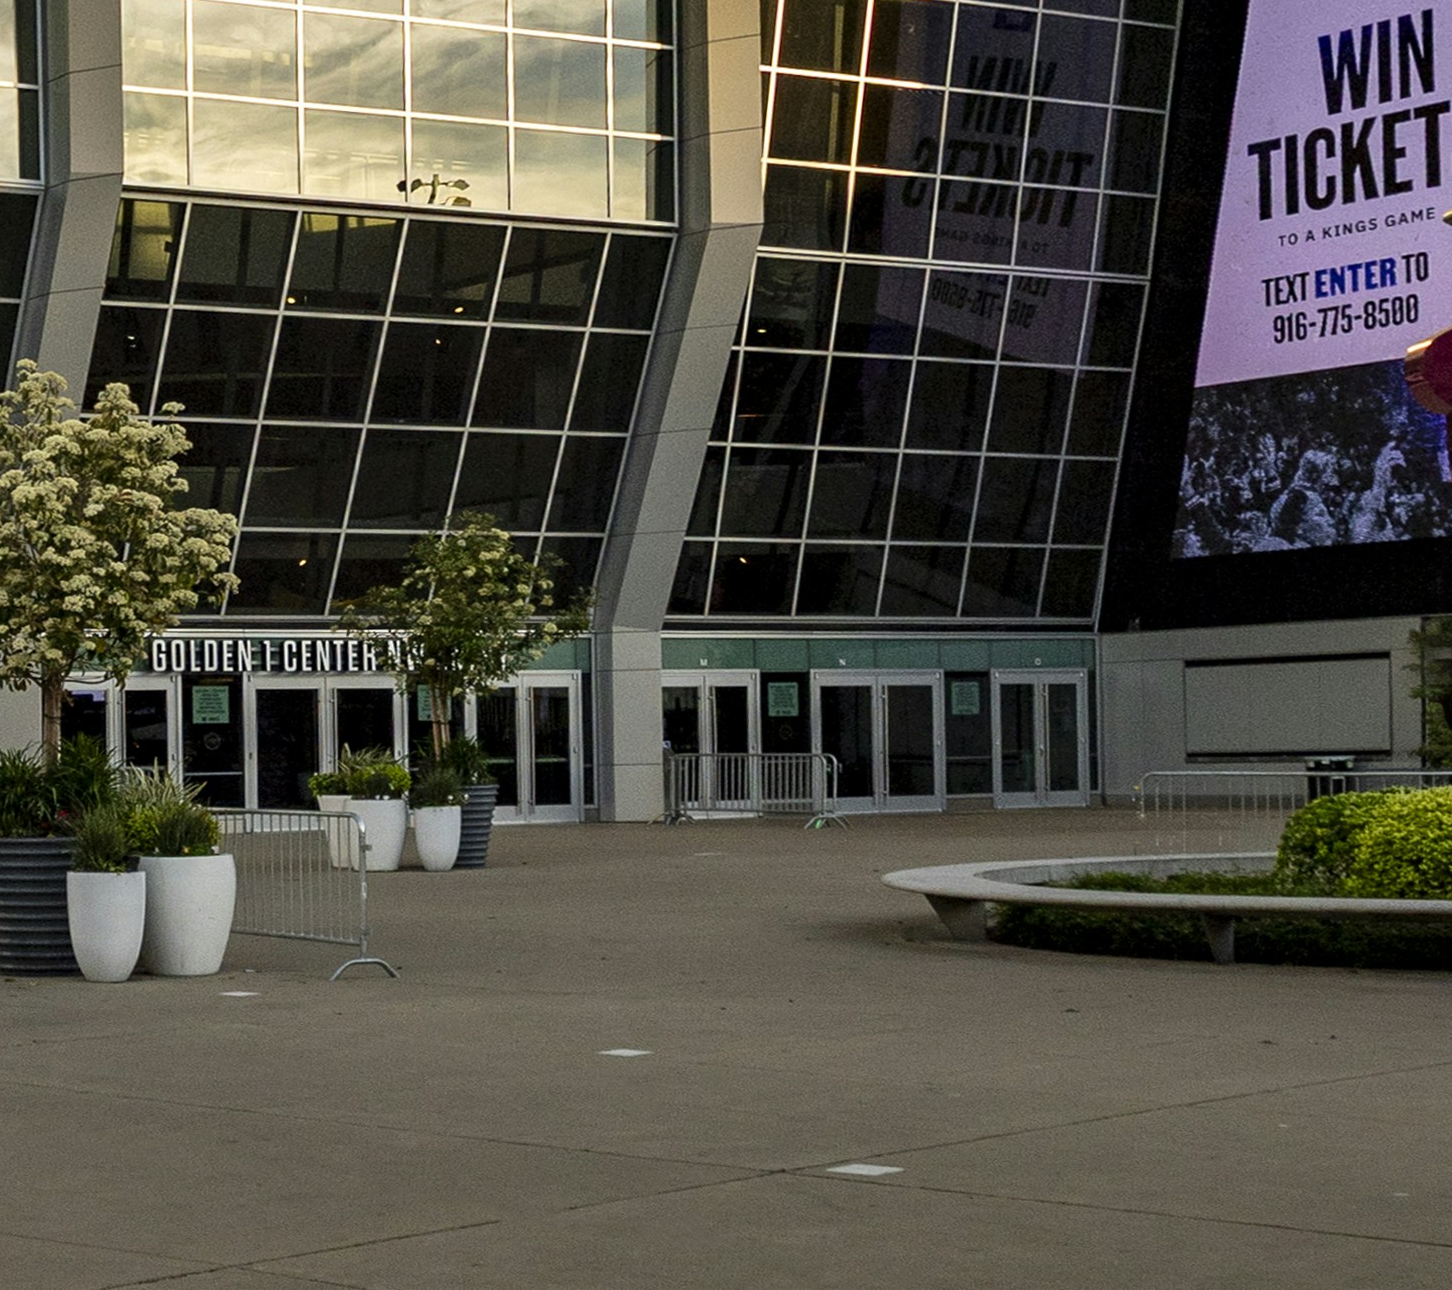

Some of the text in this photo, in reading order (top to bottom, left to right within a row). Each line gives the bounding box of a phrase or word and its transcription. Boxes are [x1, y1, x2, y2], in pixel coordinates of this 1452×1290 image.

[1317, 8, 1435, 115] WIN
[1278, 207, 1436, 247] TO A KINGS GAME
[1262, 251, 1429, 307] TEXT ENTER TO
[1273, 293, 1419, 344] 916-775-8500
[152, 638, 252, 672] GOLDEN
[263, 638, 273, 671] 1
[283, 638, 377, 672] CENTER
